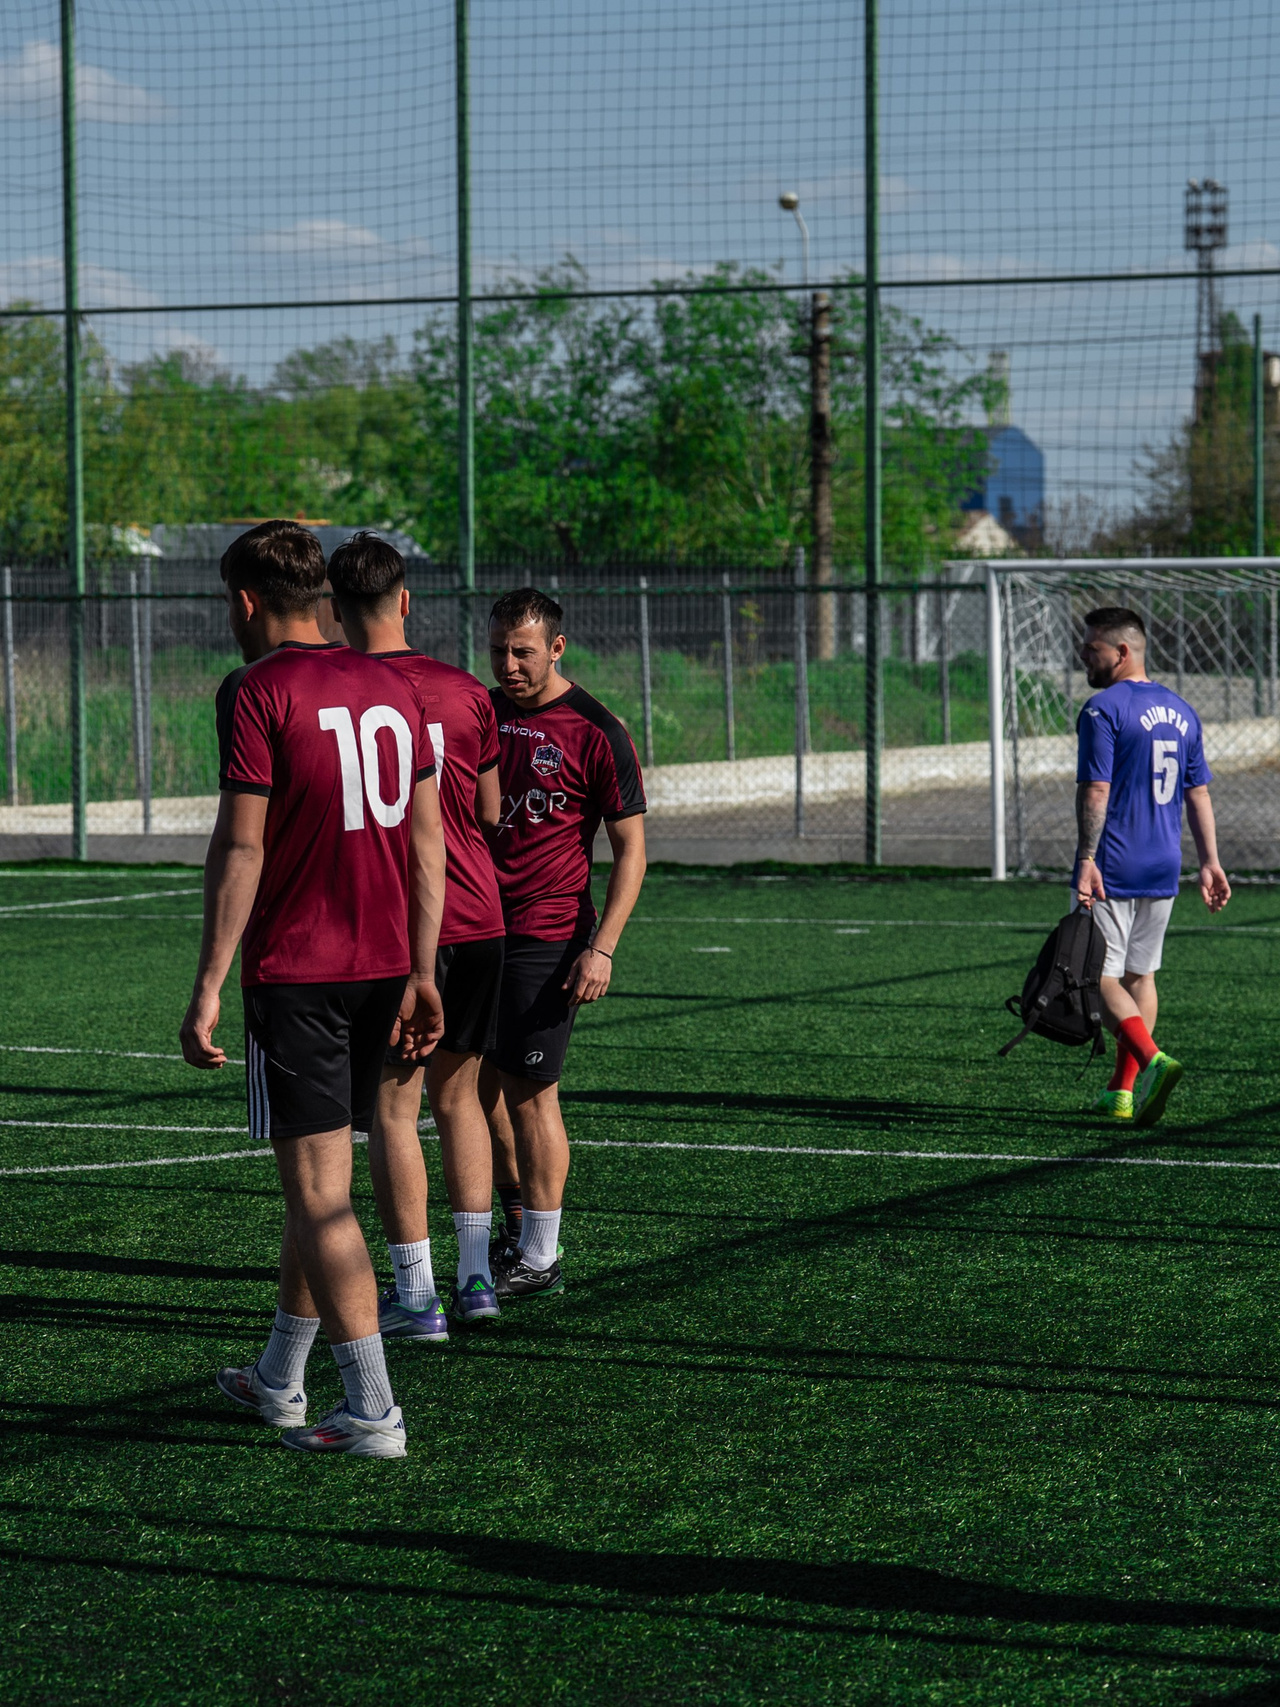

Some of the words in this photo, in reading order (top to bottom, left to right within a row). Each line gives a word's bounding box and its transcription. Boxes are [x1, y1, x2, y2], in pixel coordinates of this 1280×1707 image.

[499, 724, 546, 741] GIVOVA
[1140, 705, 1189, 737] OLIMPIA
[318, 704, 413, 832] 10
[1153, 739, 1179, 805] 5
